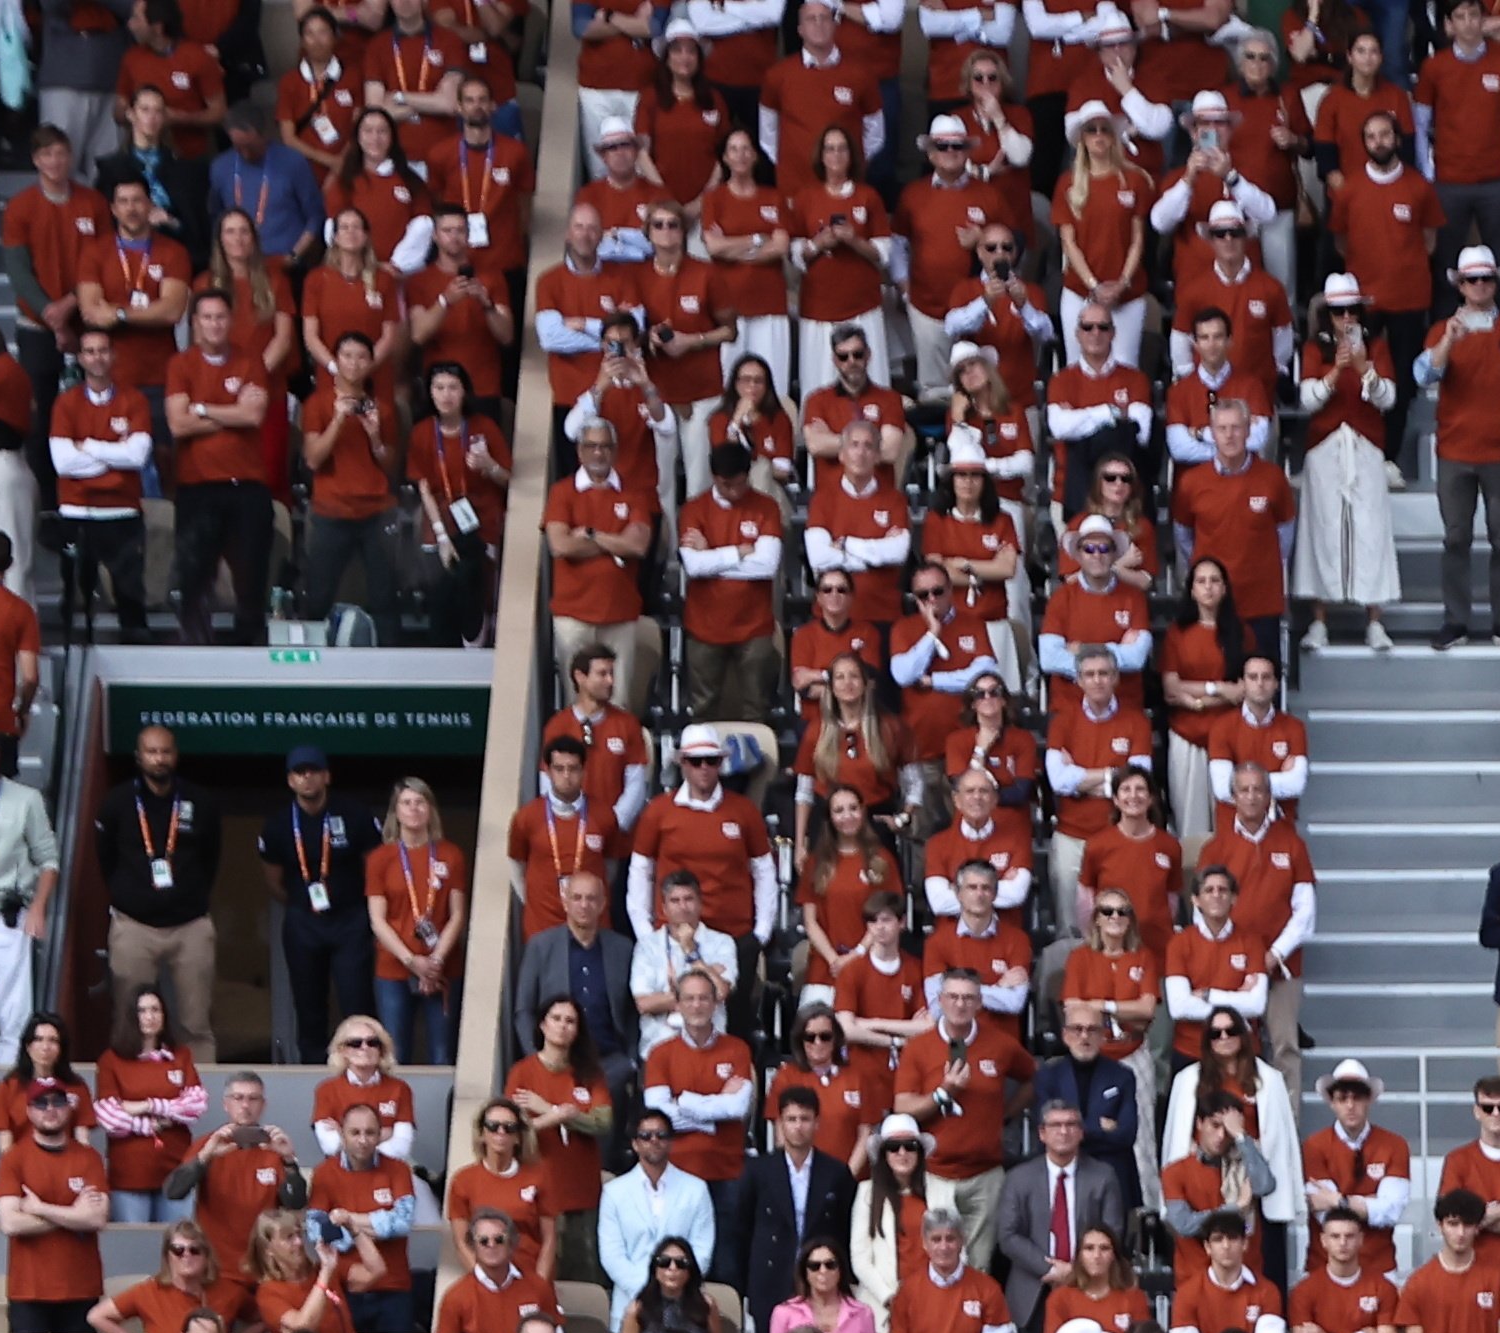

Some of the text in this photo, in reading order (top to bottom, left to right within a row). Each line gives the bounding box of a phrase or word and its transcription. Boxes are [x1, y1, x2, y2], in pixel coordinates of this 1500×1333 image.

[263, 711, 367, 728] FRANÇAISE
[374, 711, 396, 727] DE
[404, 711, 472, 728] TENNIS
